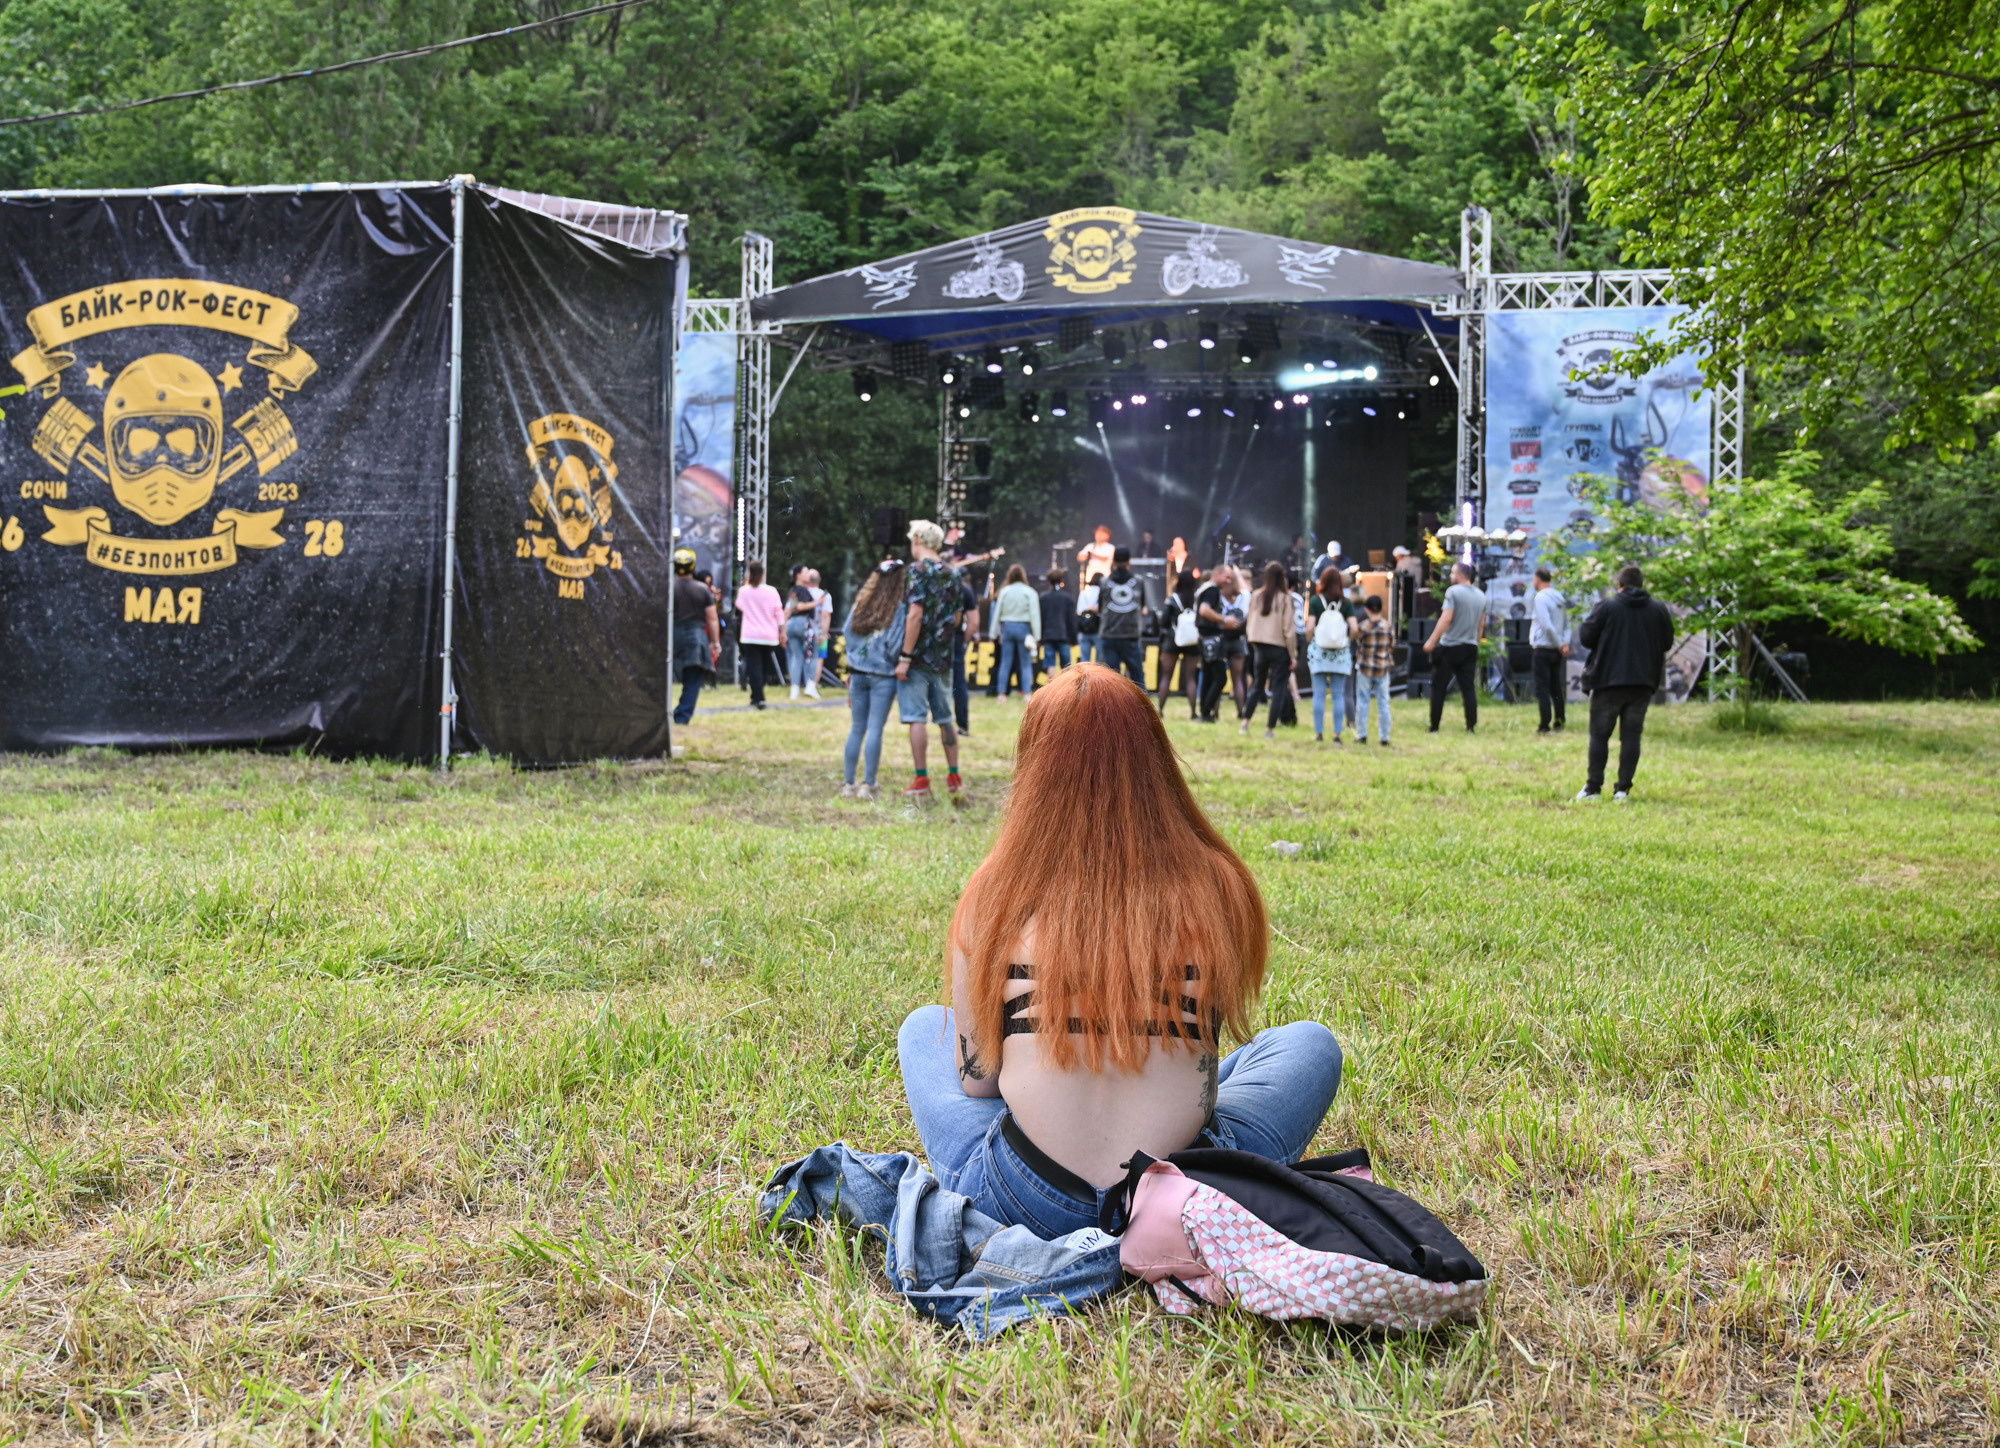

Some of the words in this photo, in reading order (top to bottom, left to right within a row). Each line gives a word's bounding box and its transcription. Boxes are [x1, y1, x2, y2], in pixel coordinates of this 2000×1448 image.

[60, 288, 271, 328] БАЙК-РОК-ФЕСТ
[20, 480, 68, 500] СОЧИ
[258, 483, 299, 501] 2023
[0, 515, 25, 552] 6
[304, 520, 345, 557] 28
[97, 545, 224, 569] #БЕЗПОНТОВ
[516, 537, 531, 558] 26
[558, 579, 585, 600] МАЯ
[124, 586, 203, 625] МАЯ
